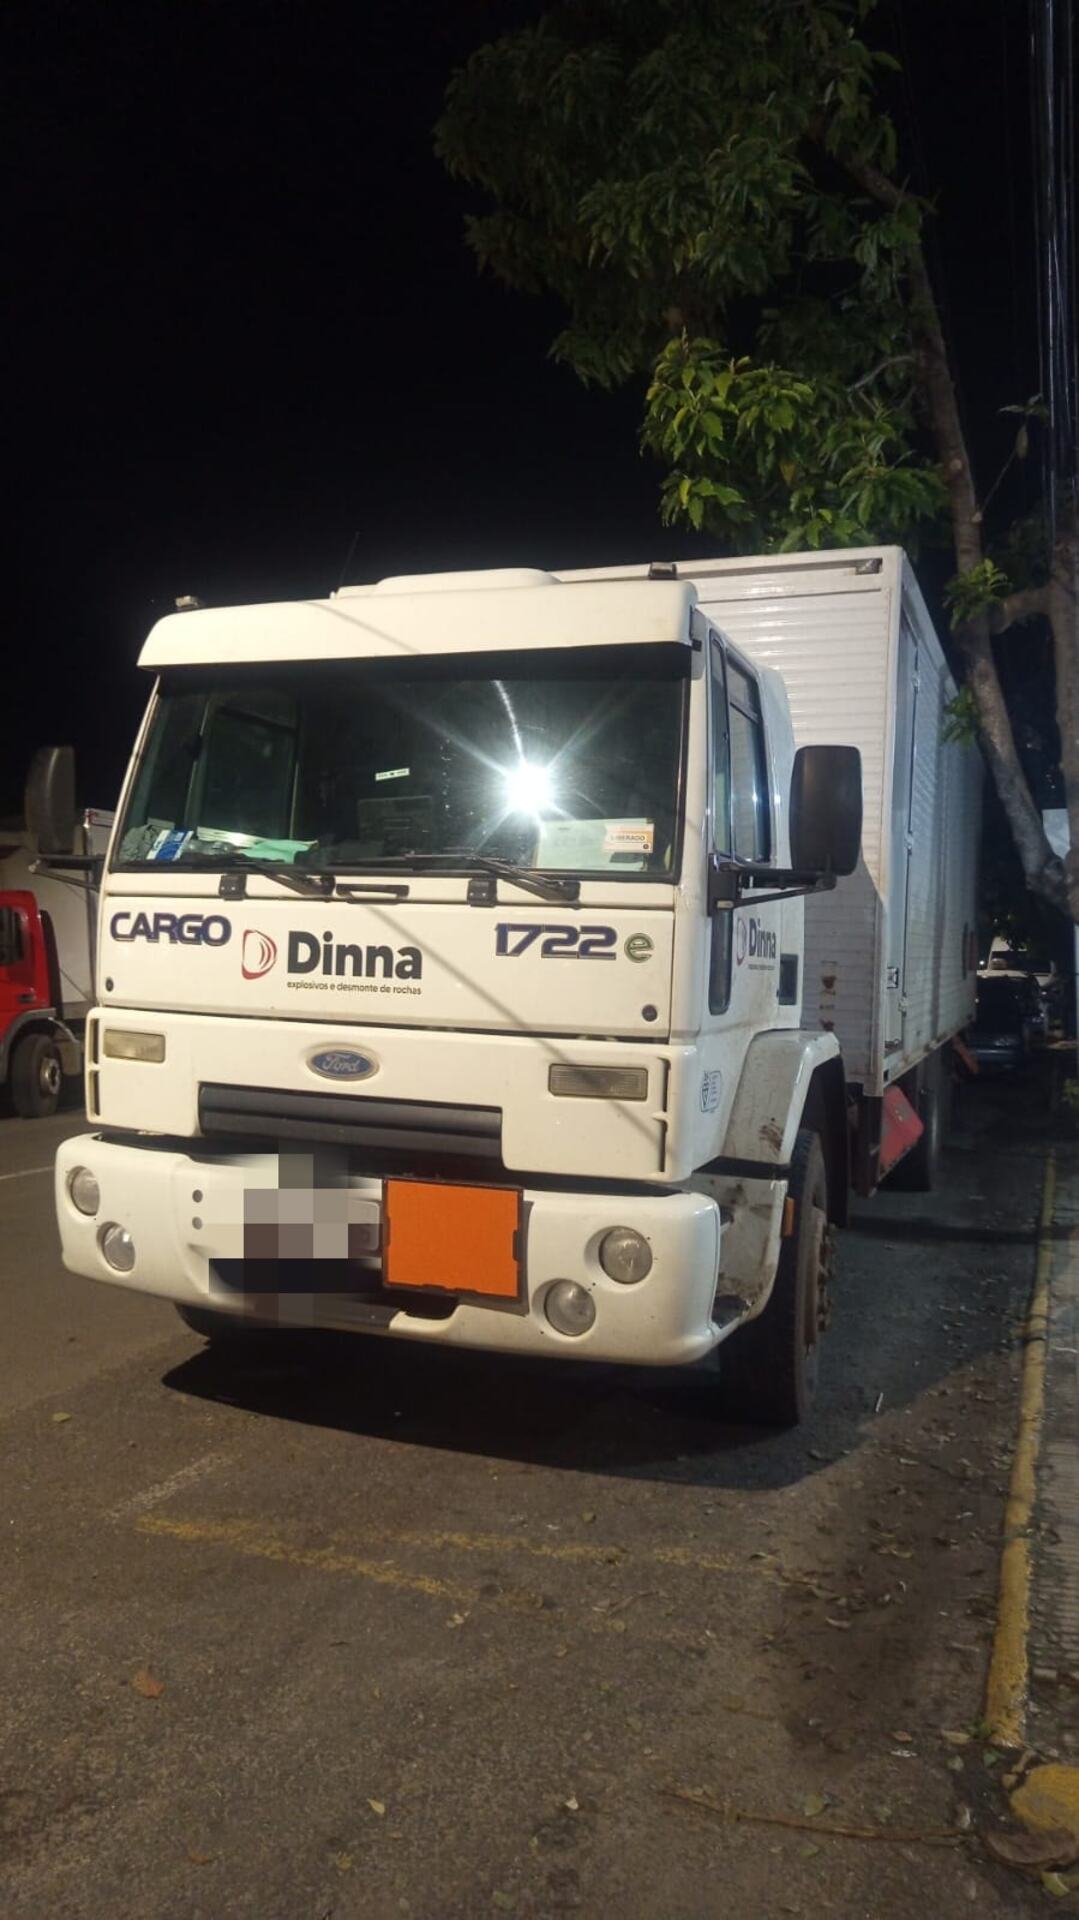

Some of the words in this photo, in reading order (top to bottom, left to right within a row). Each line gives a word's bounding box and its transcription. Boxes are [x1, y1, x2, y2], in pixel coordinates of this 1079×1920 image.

[109, 911, 232, 947] CARGO
[495, 923, 617, 960] 1722
[748, 918, 777, 960] Dinna
[287, 930, 422, 980] Dinna
[286, 981, 328, 991] explosivos
[336, 983, 378, 993] desmonte
[379, 984, 391, 994] de
[393, 985, 422, 995] rochas
[322, 1053, 361, 1072] Ford
